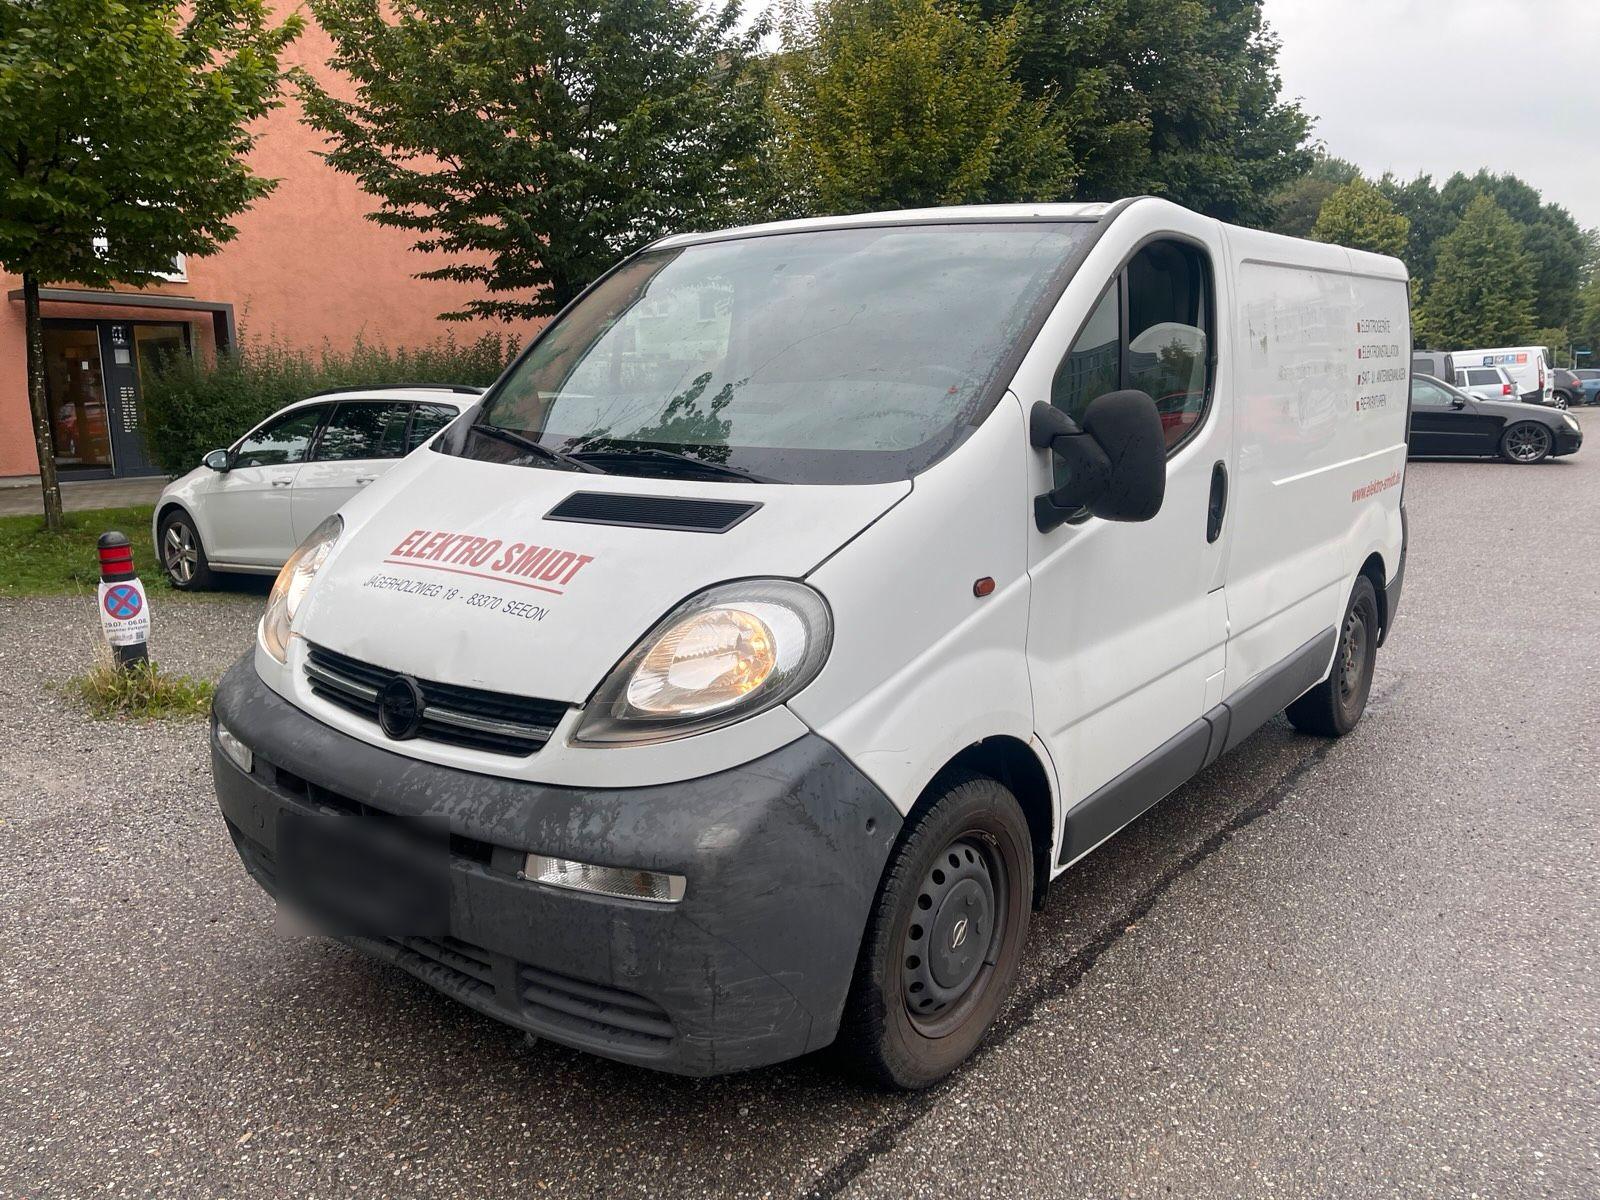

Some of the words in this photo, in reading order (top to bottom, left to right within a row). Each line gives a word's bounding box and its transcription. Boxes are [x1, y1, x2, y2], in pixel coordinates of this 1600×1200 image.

[390, 530, 503, 568] ELEKTRO
[491, 542, 595, 586] SMIDT
[363, 573, 443, 597] JÄGERHOLZWEG
[443, 587, 459, 600] 18
[466, 593, 502, 610] 83370
[502, 600, 550, 622] SEEON
